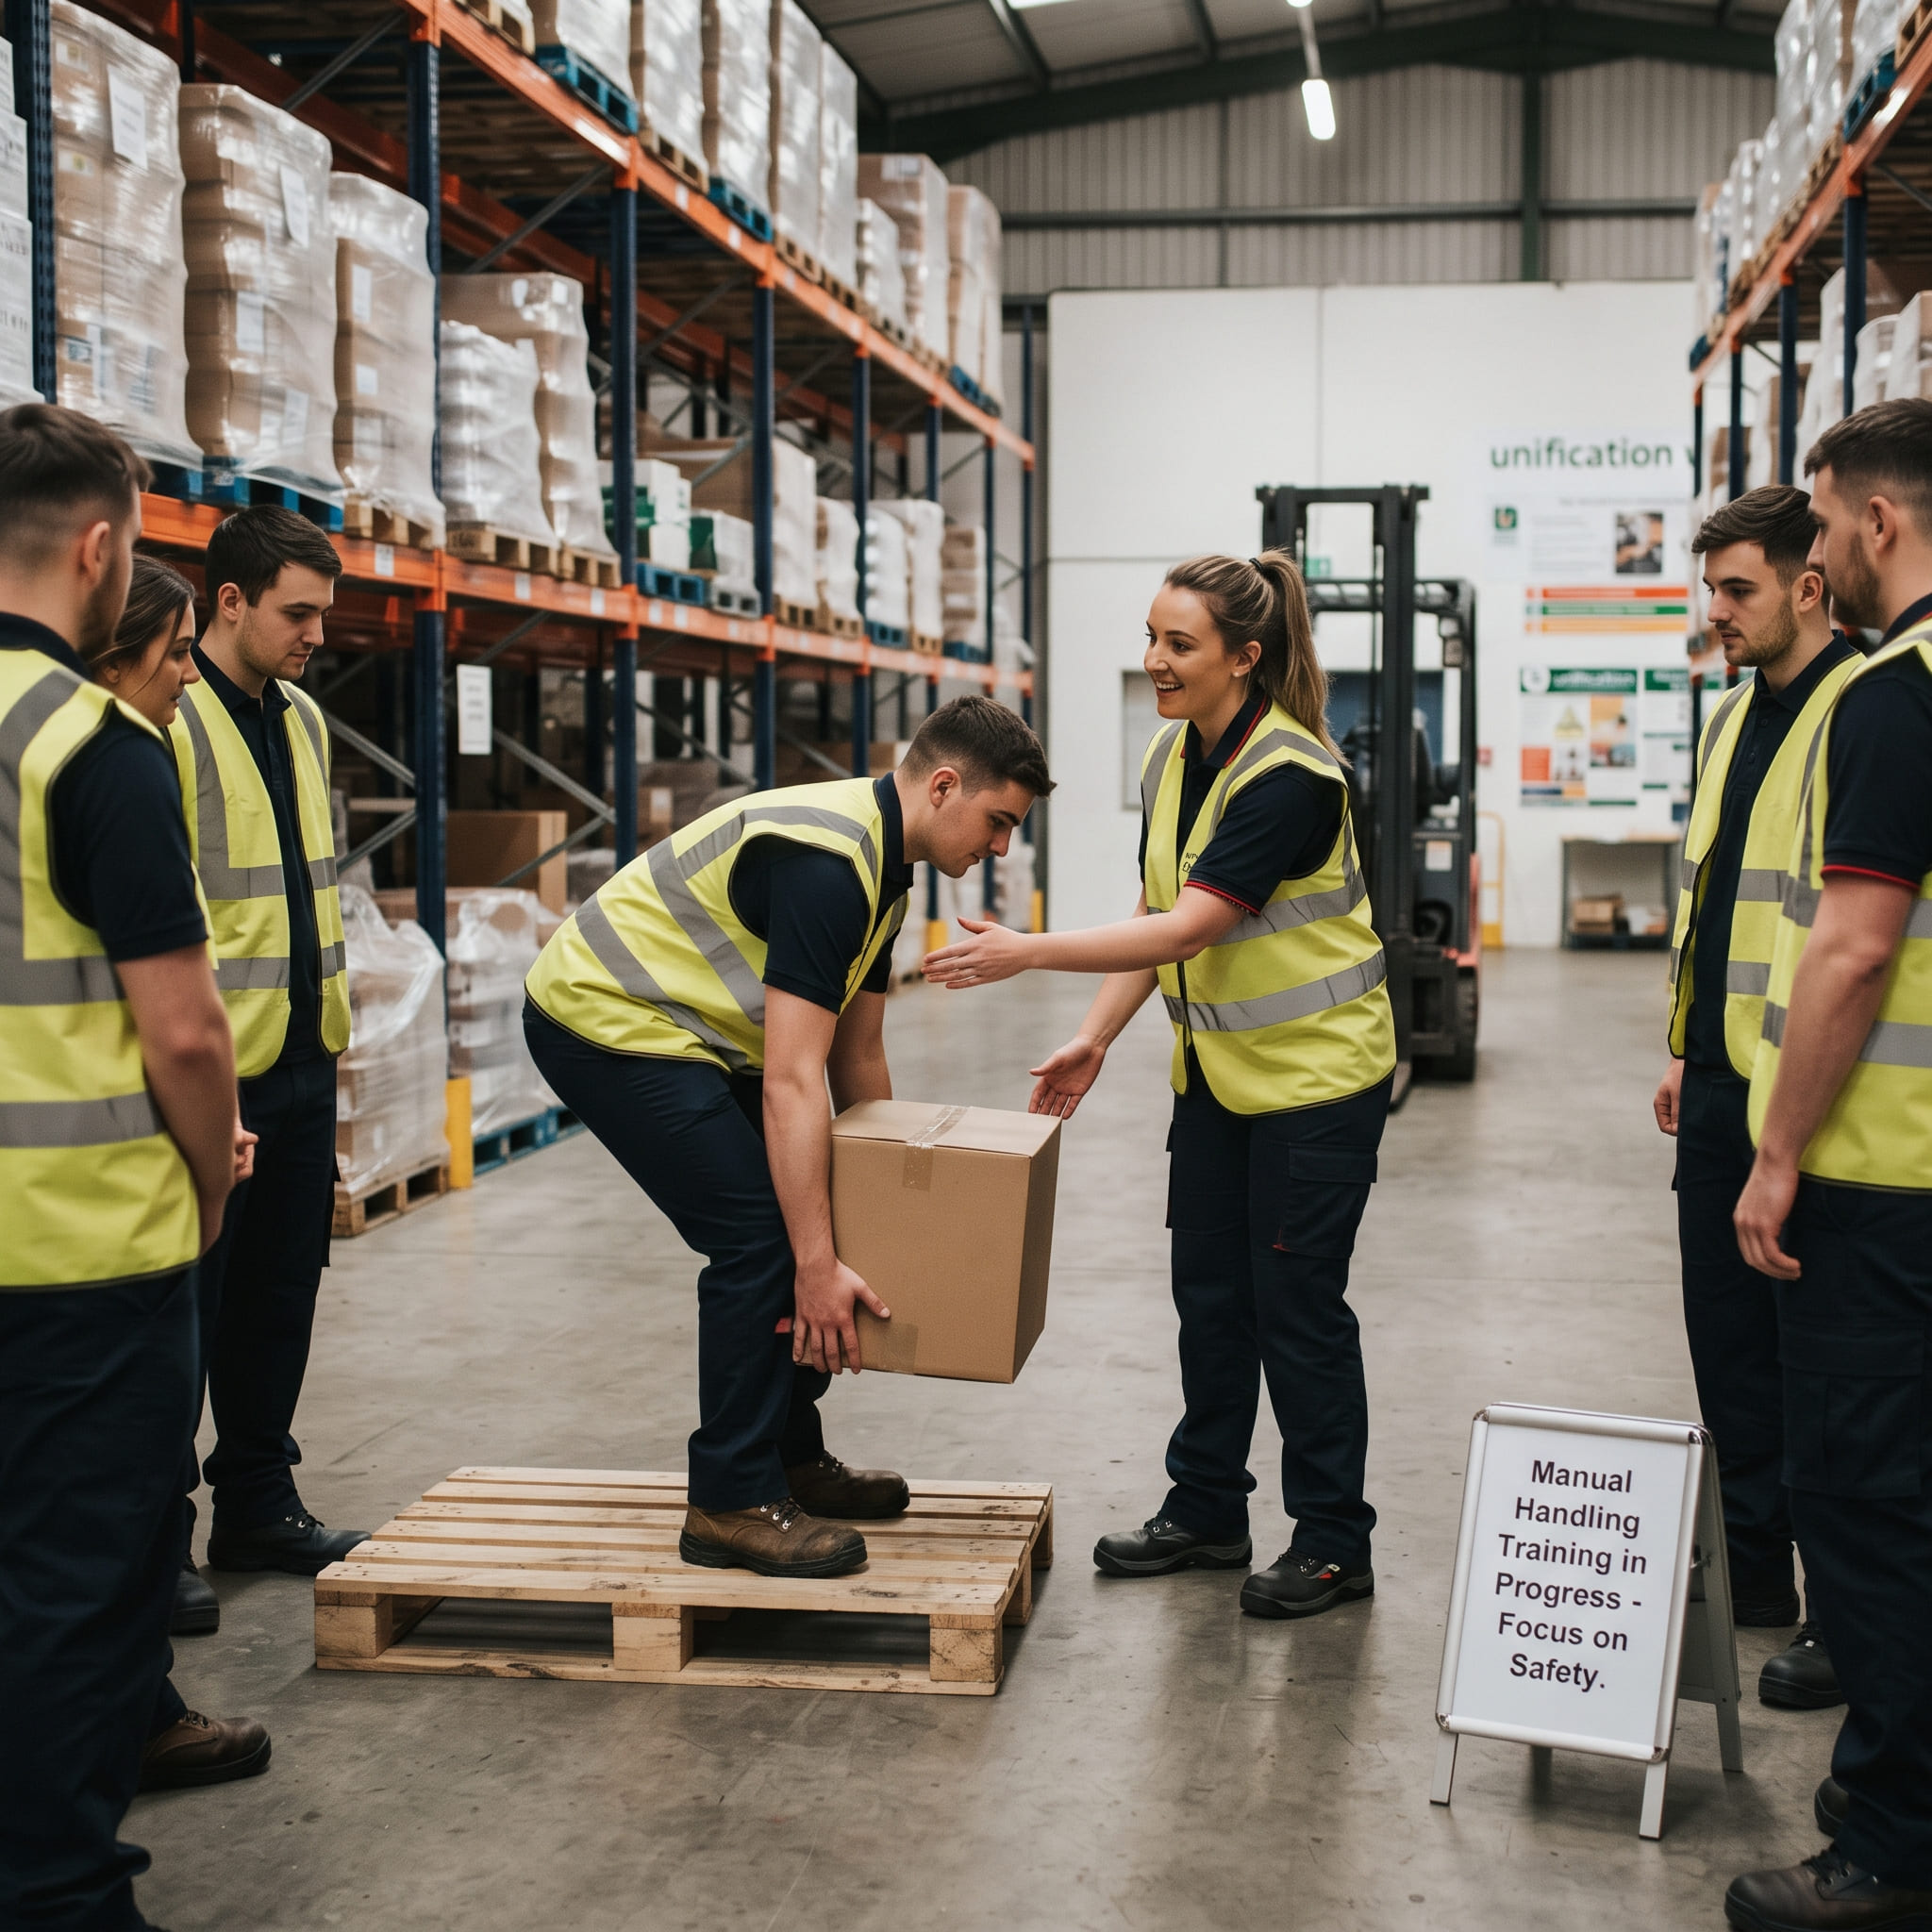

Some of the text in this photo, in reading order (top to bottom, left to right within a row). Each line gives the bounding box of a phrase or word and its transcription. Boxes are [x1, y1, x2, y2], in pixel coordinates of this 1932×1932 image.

[1491, 437, 1674, 469] unification
[1531, 1459, 1633, 1493] Manual
[1515, 1496, 1641, 1540] Handling
[1498, 1533, 1647, 1575] Training in
[1495, 1572, 1622, 1610] Progress
[1498, 1611, 1628, 1652] Focus on
[1509, 1653, 1606, 1693] Safety.
